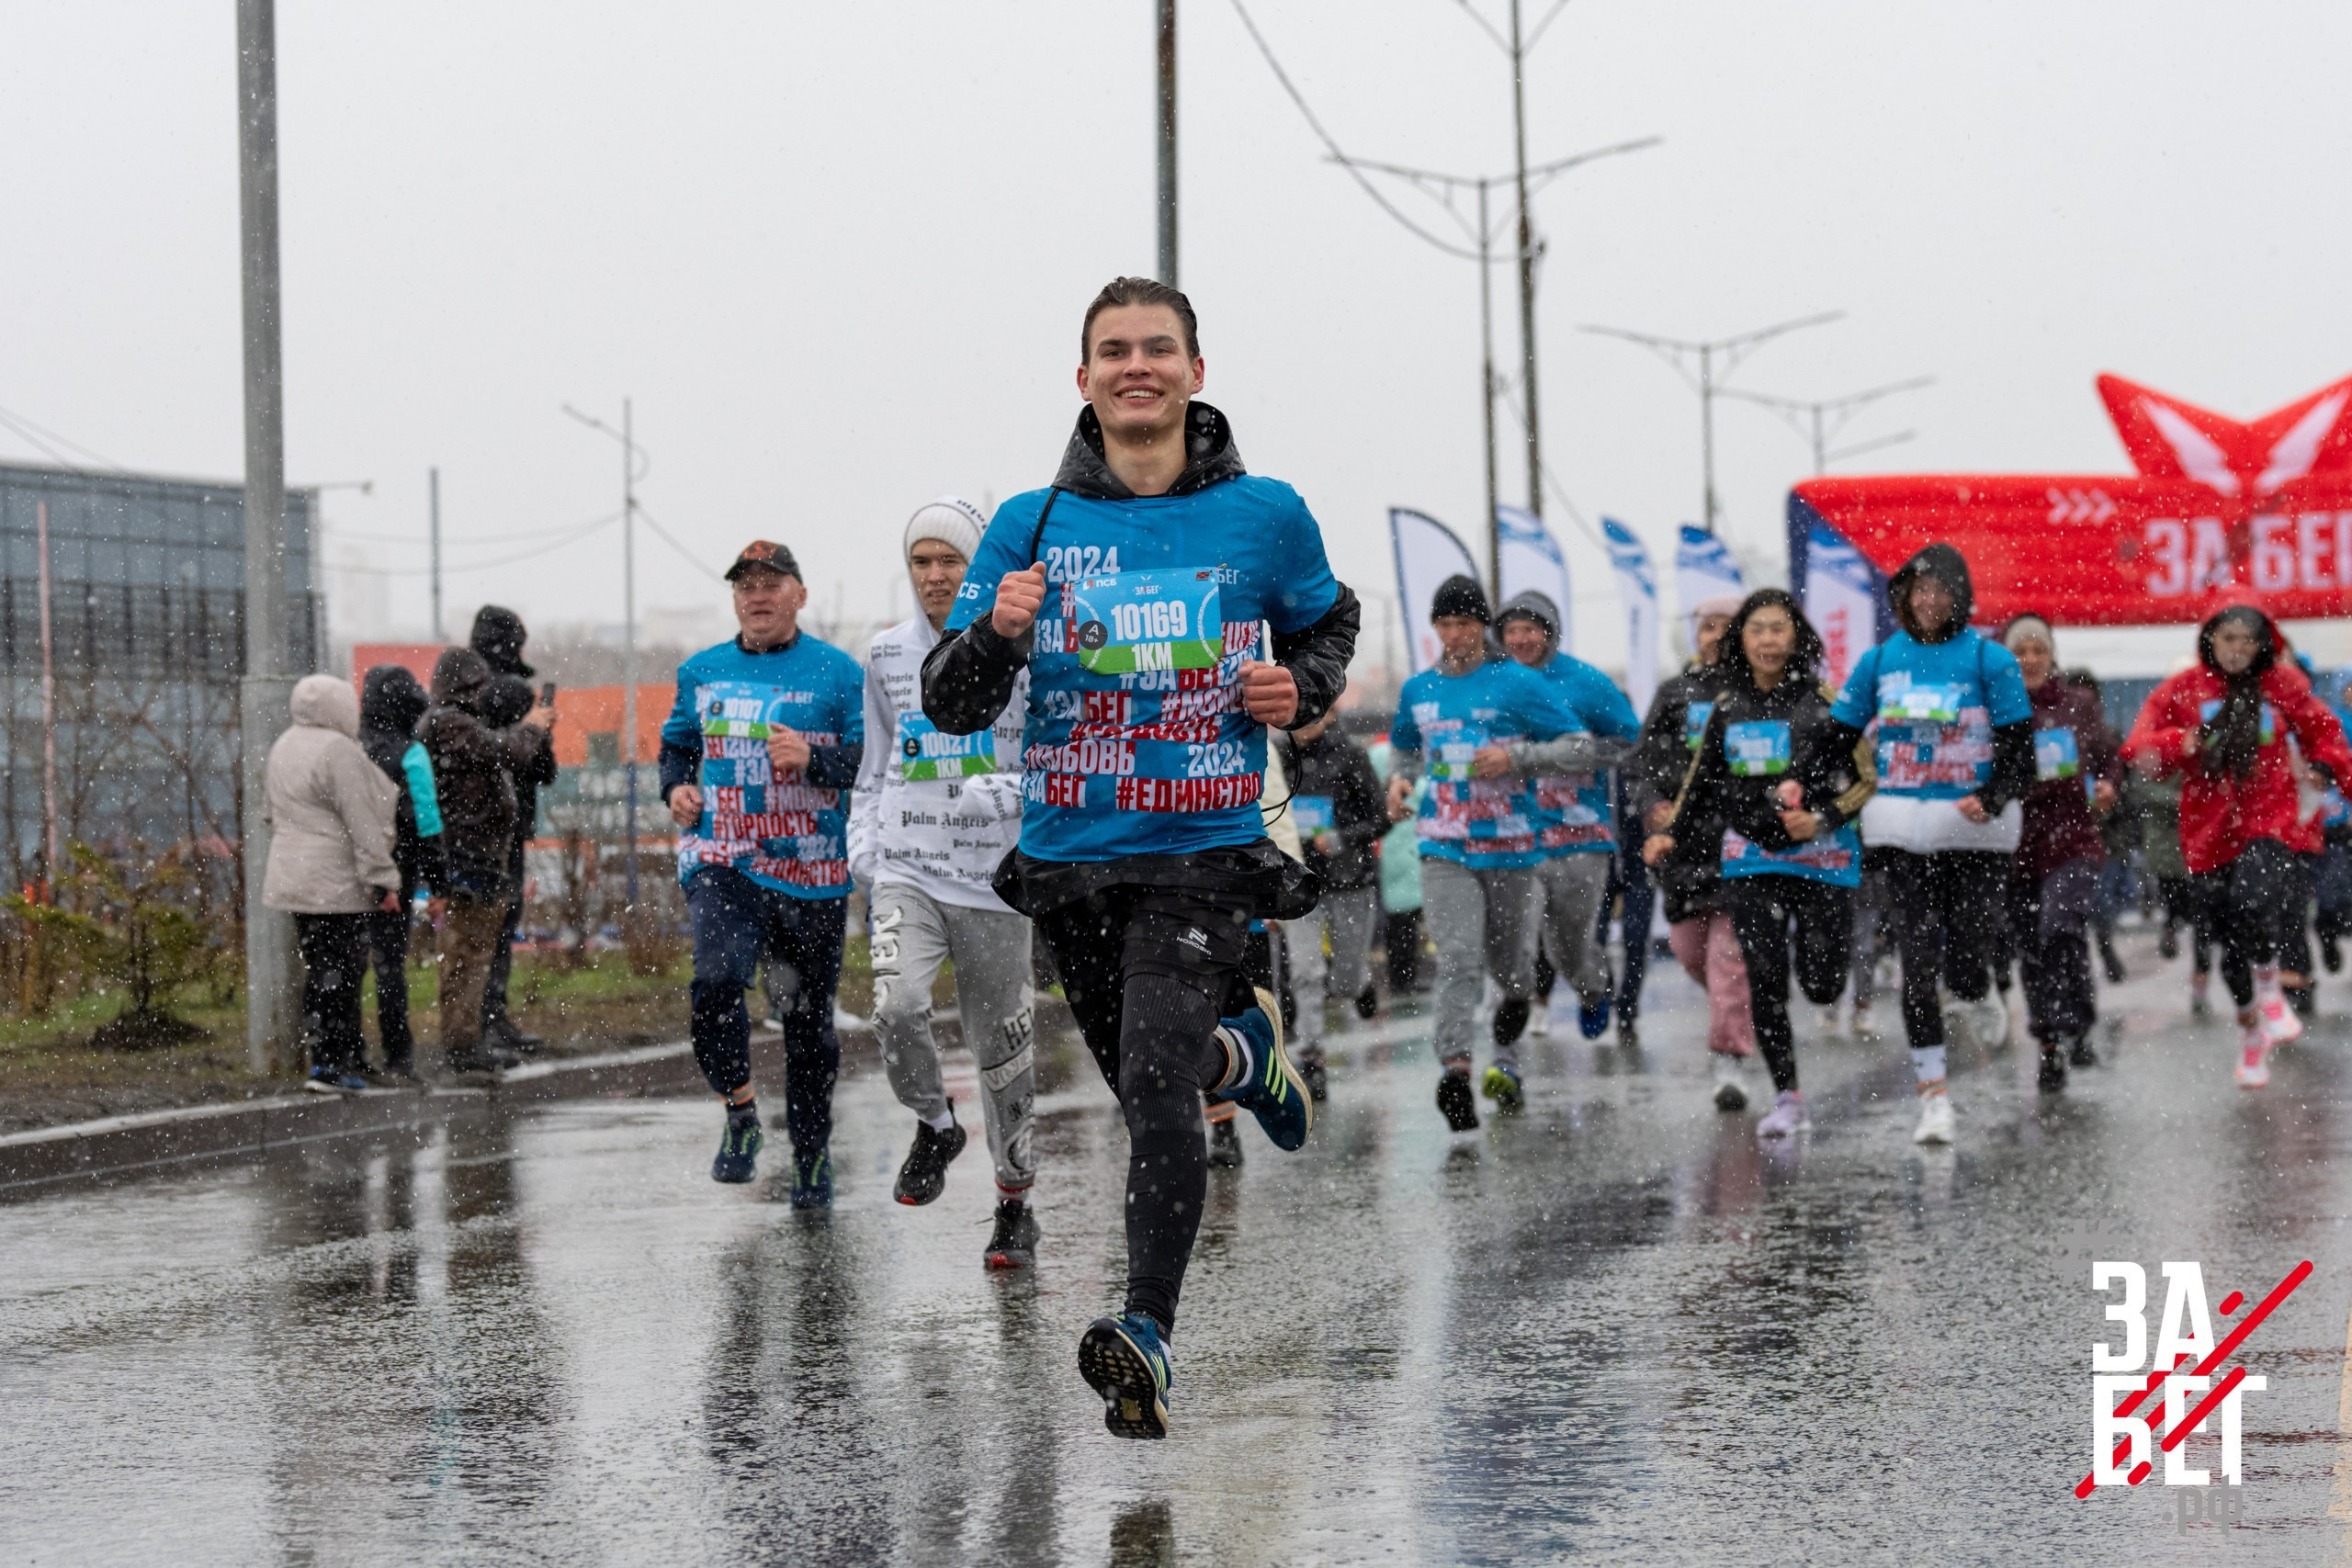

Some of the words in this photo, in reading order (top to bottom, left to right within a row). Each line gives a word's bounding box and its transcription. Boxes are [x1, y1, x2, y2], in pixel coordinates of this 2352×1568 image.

[1047, 546, 1121, 582] 2024
[956, 581, 981, 600] СБ
[1095, 578, 1117, 588] ПСБ
[1111, 600, 1188, 641] 10169
[1188, 739, 1246, 777] 2024
[901, 810, 937, 828] Palm
[1176, 936, 1212, 956] NORDSKI
